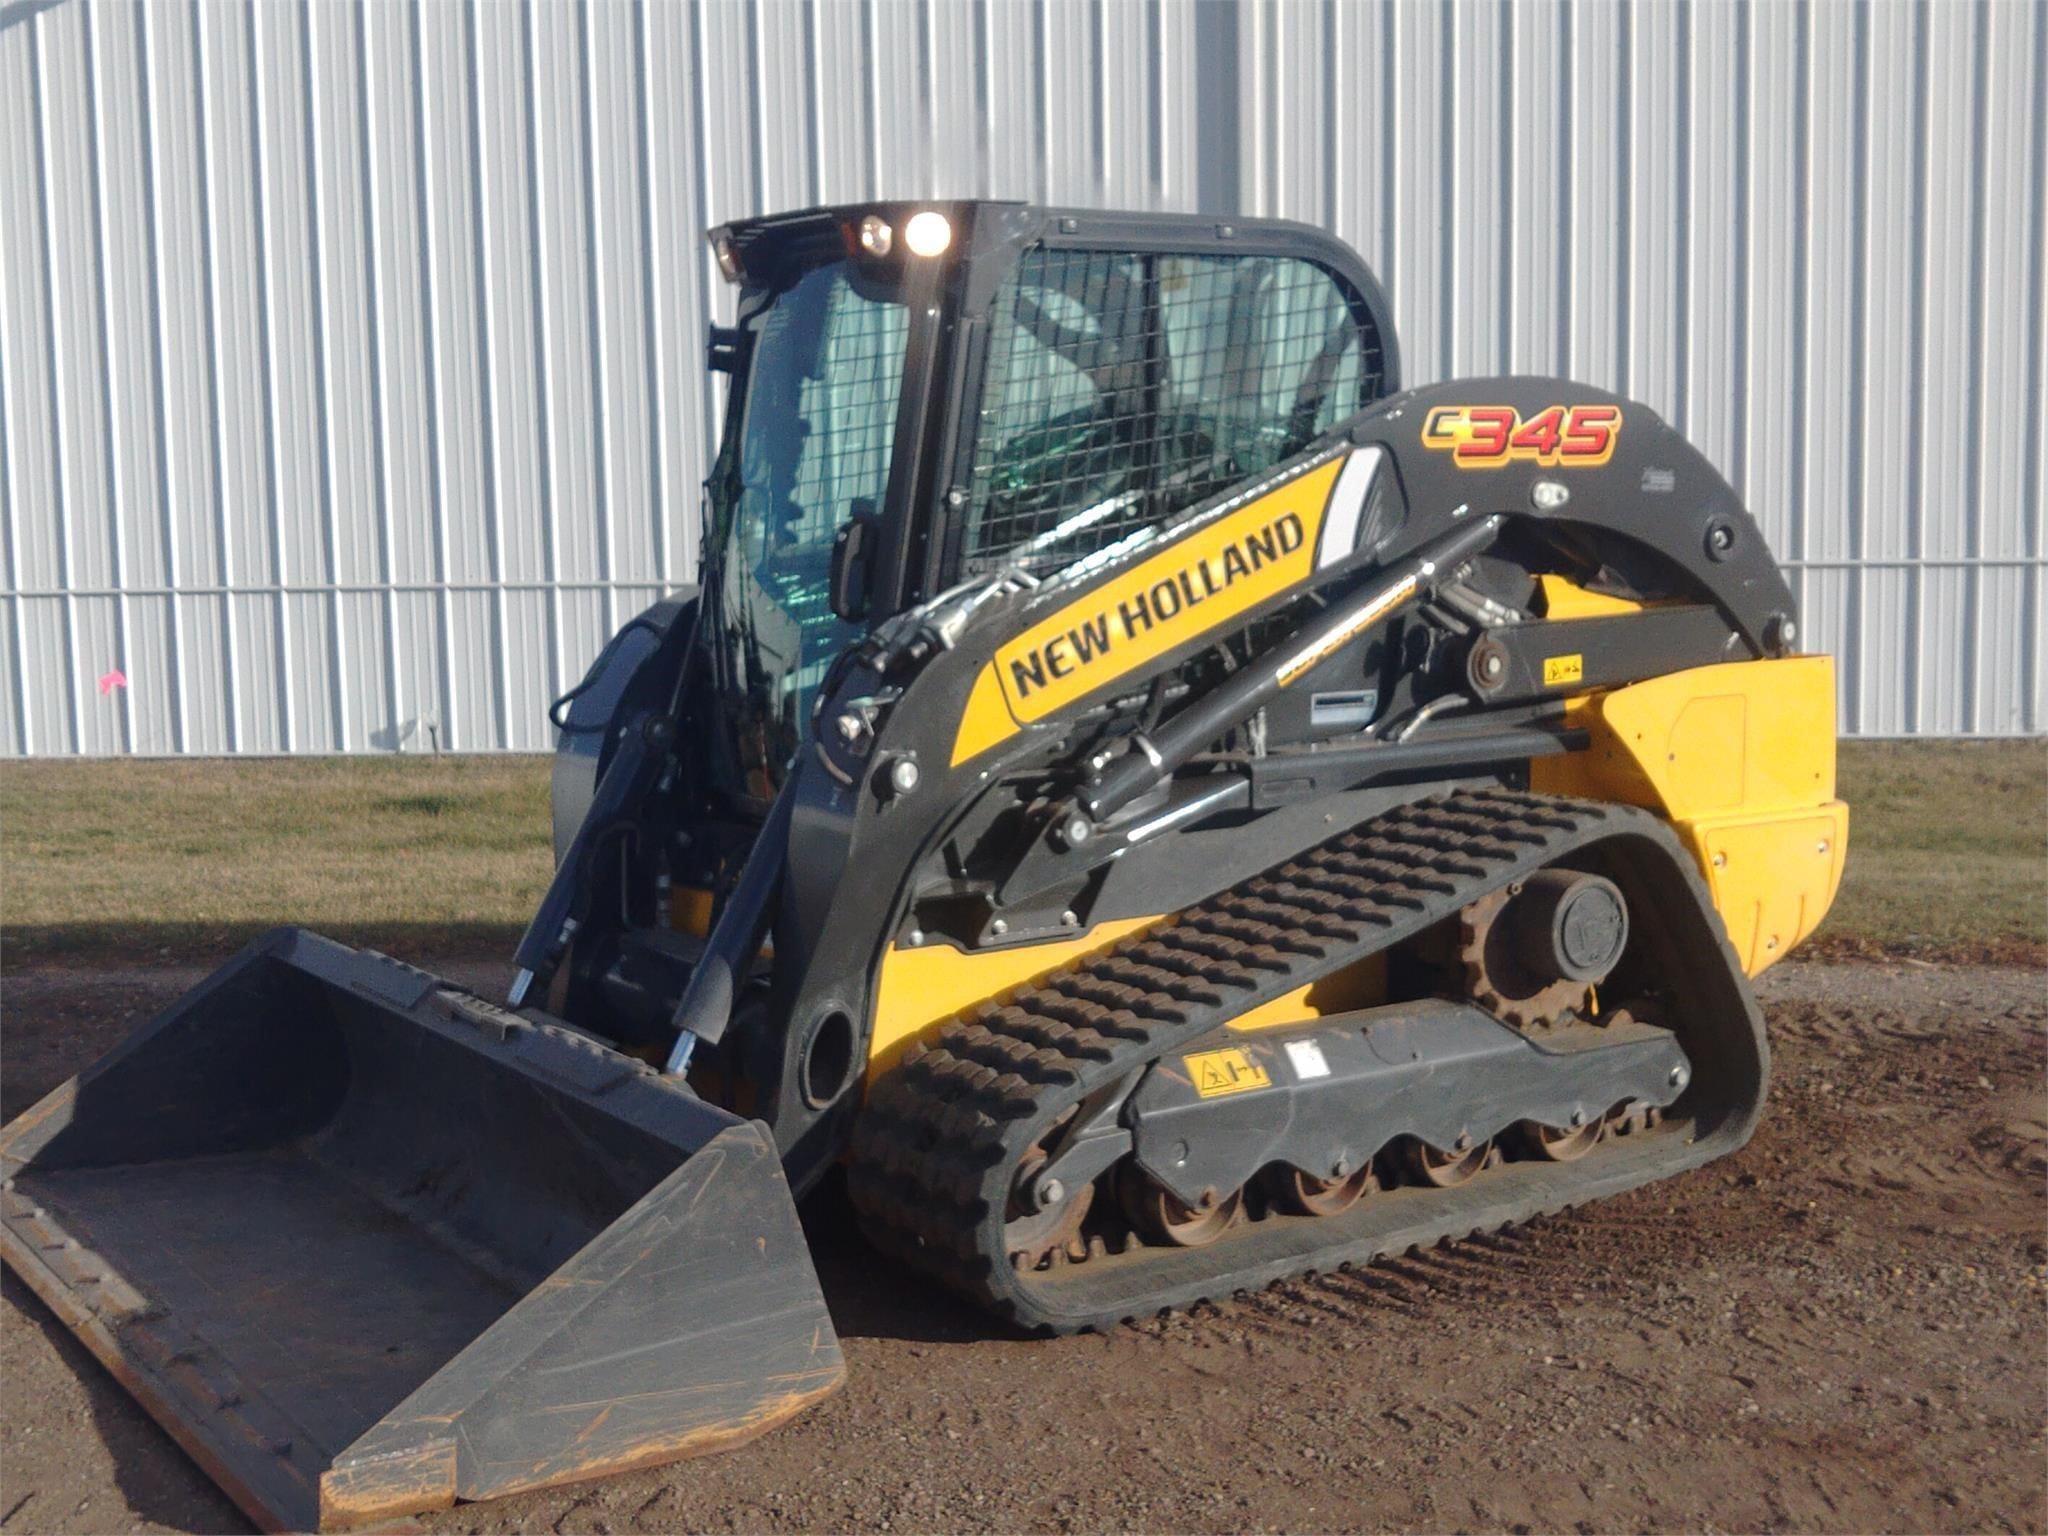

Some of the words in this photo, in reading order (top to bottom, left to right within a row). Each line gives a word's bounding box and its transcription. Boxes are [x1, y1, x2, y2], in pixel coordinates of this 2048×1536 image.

[1424, 407, 1620, 461] C345
[1010, 612, 1115, 699] NEW
[1117, 511, 1305, 640] HOLLAND
